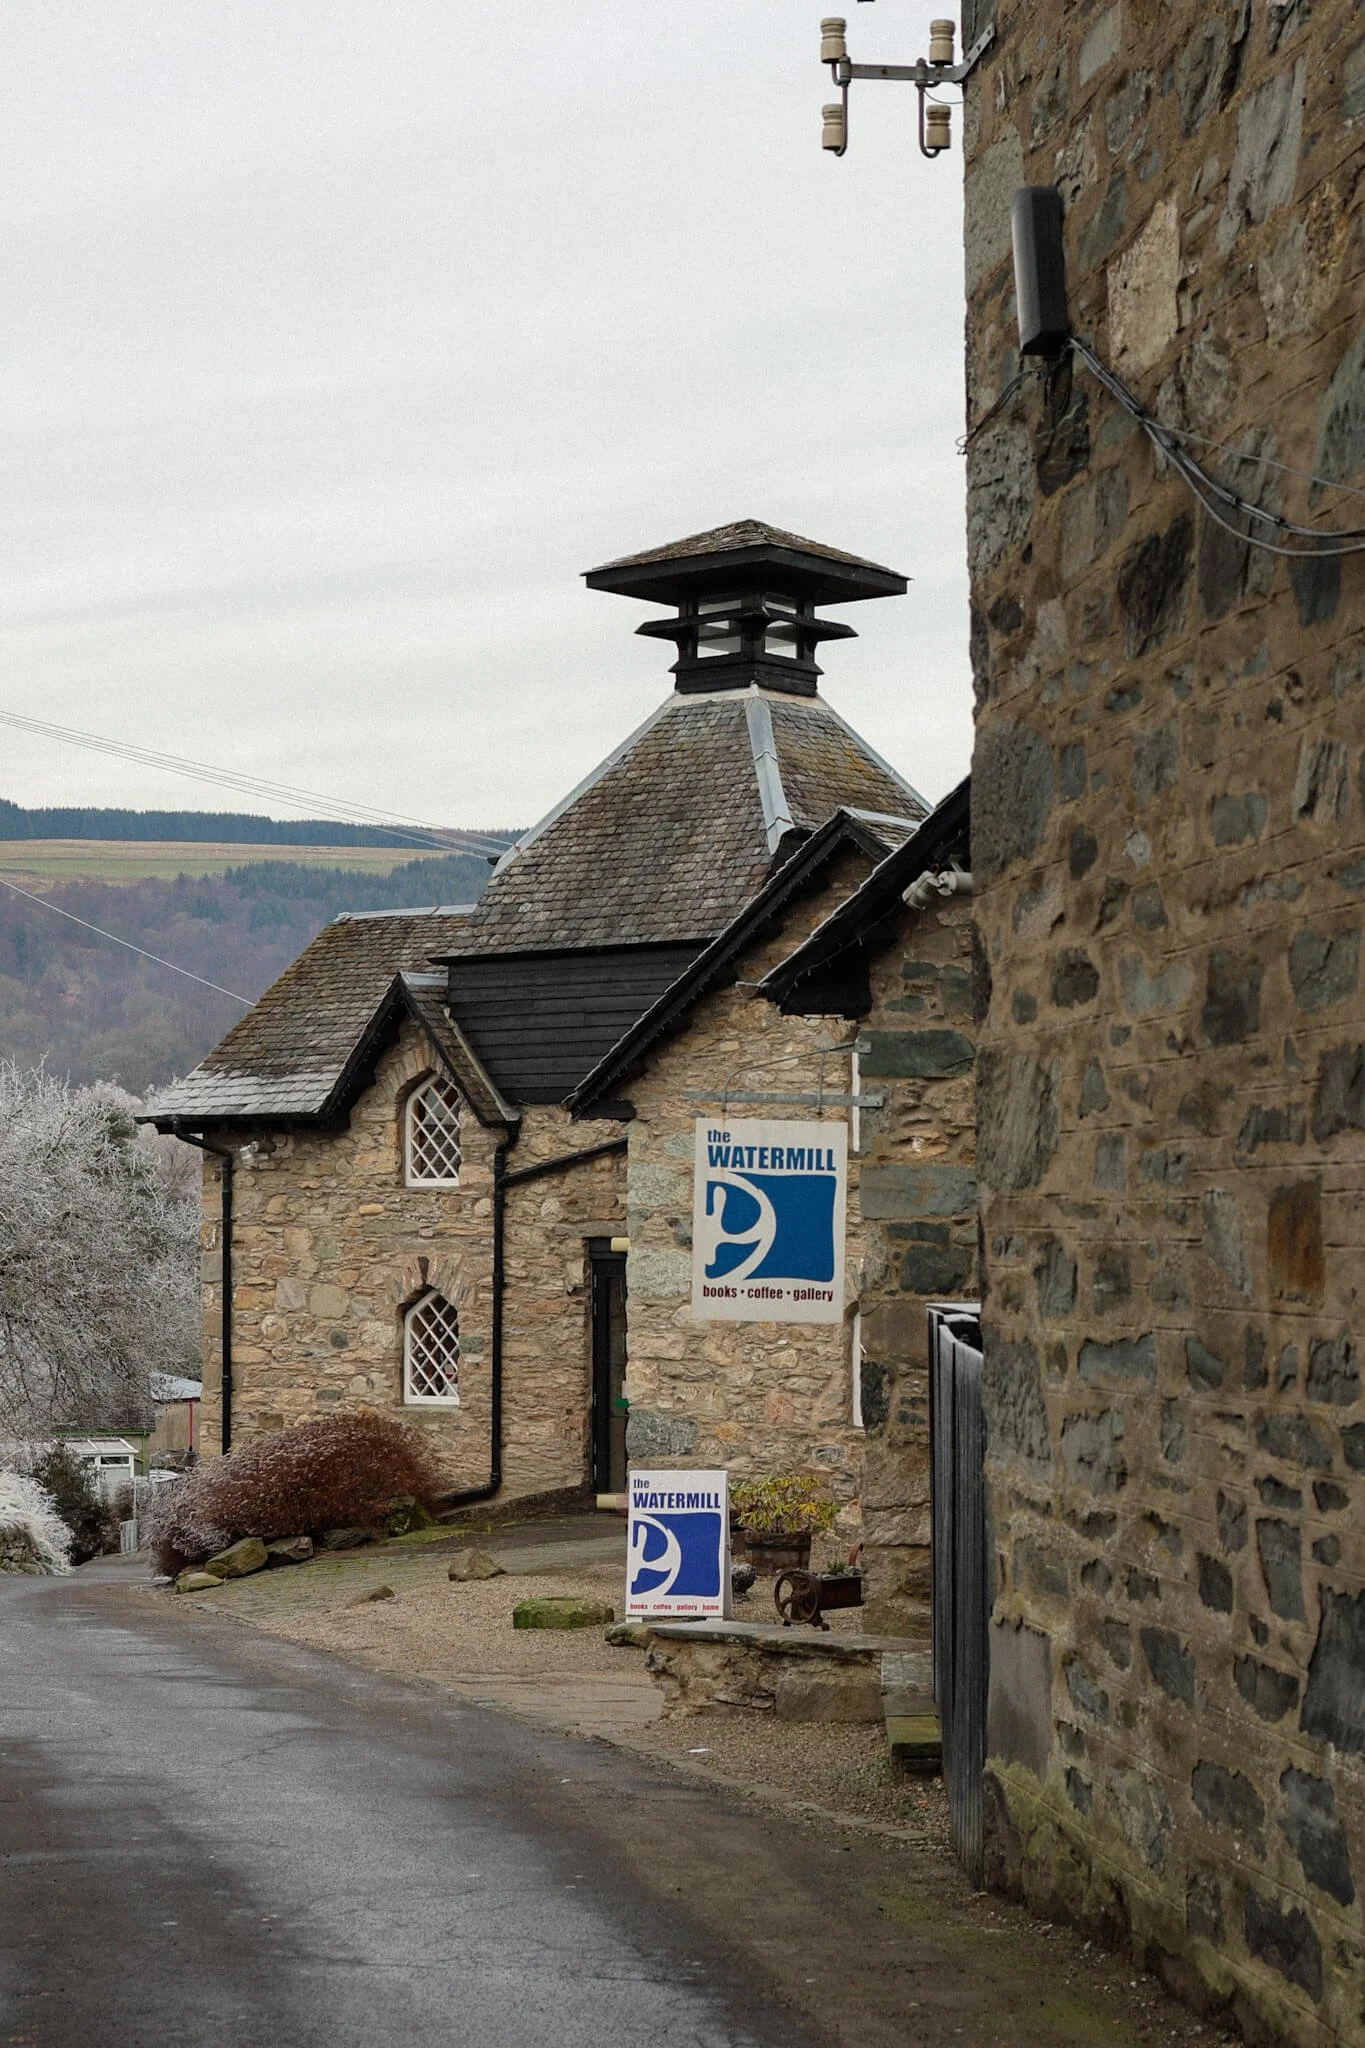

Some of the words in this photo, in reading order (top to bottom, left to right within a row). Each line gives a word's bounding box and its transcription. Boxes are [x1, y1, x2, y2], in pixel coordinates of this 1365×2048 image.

[707, 1129, 731, 1143] the
[707, 1145, 837, 1171] WATERMILL
[703, 1285, 737, 1298] books
[747, 1287, 783, 1299] coffee
[793, 1288, 833, 1302] gallery
[633, 1478, 650, 1488] the
[633, 1492, 721, 1509] WATERMILL
[676, 1603, 698, 1611] gallery
